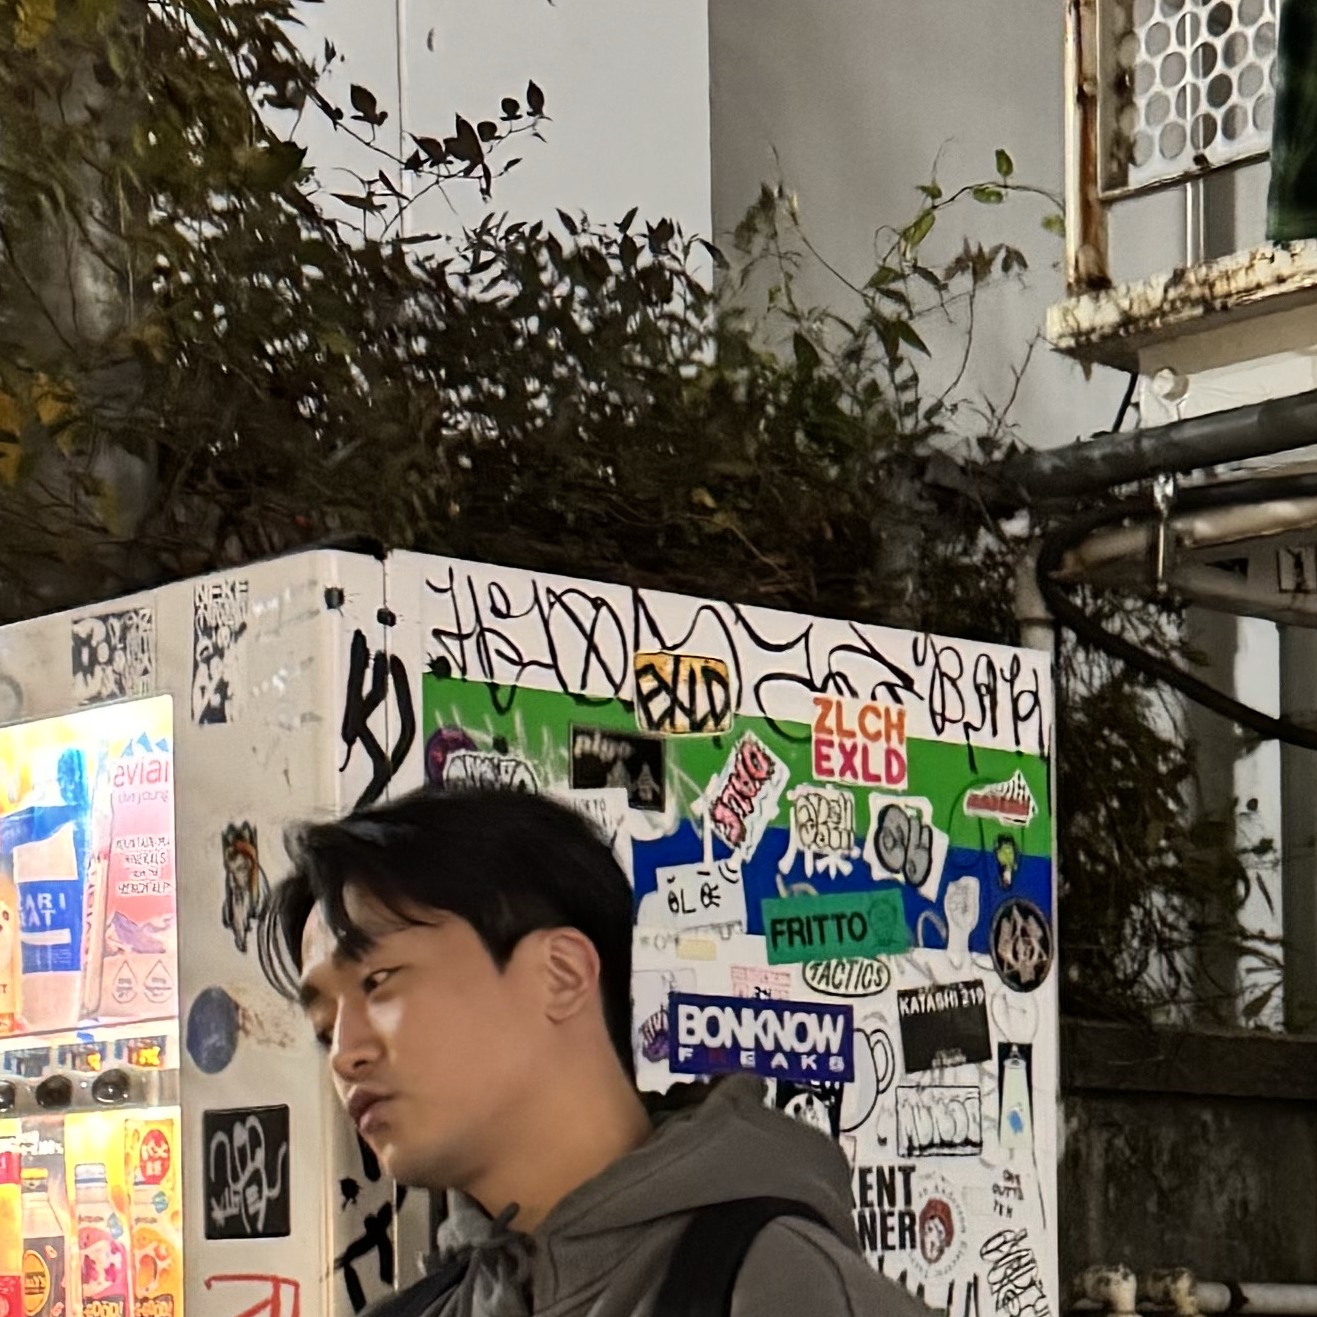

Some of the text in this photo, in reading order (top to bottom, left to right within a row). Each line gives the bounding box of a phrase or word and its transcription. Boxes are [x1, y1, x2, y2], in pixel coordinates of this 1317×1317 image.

[814, 697, 907, 746] ZLCH
[814, 739, 907, 785] EXLD
[770, 912, 867, 951] FRITTO
[809, 960, 885, 991] TACTICS
[677, 1004, 846, 1055] BONKNOW
[855, 1164, 916, 1208] ENT
[857, 1208, 917, 1252] NER
